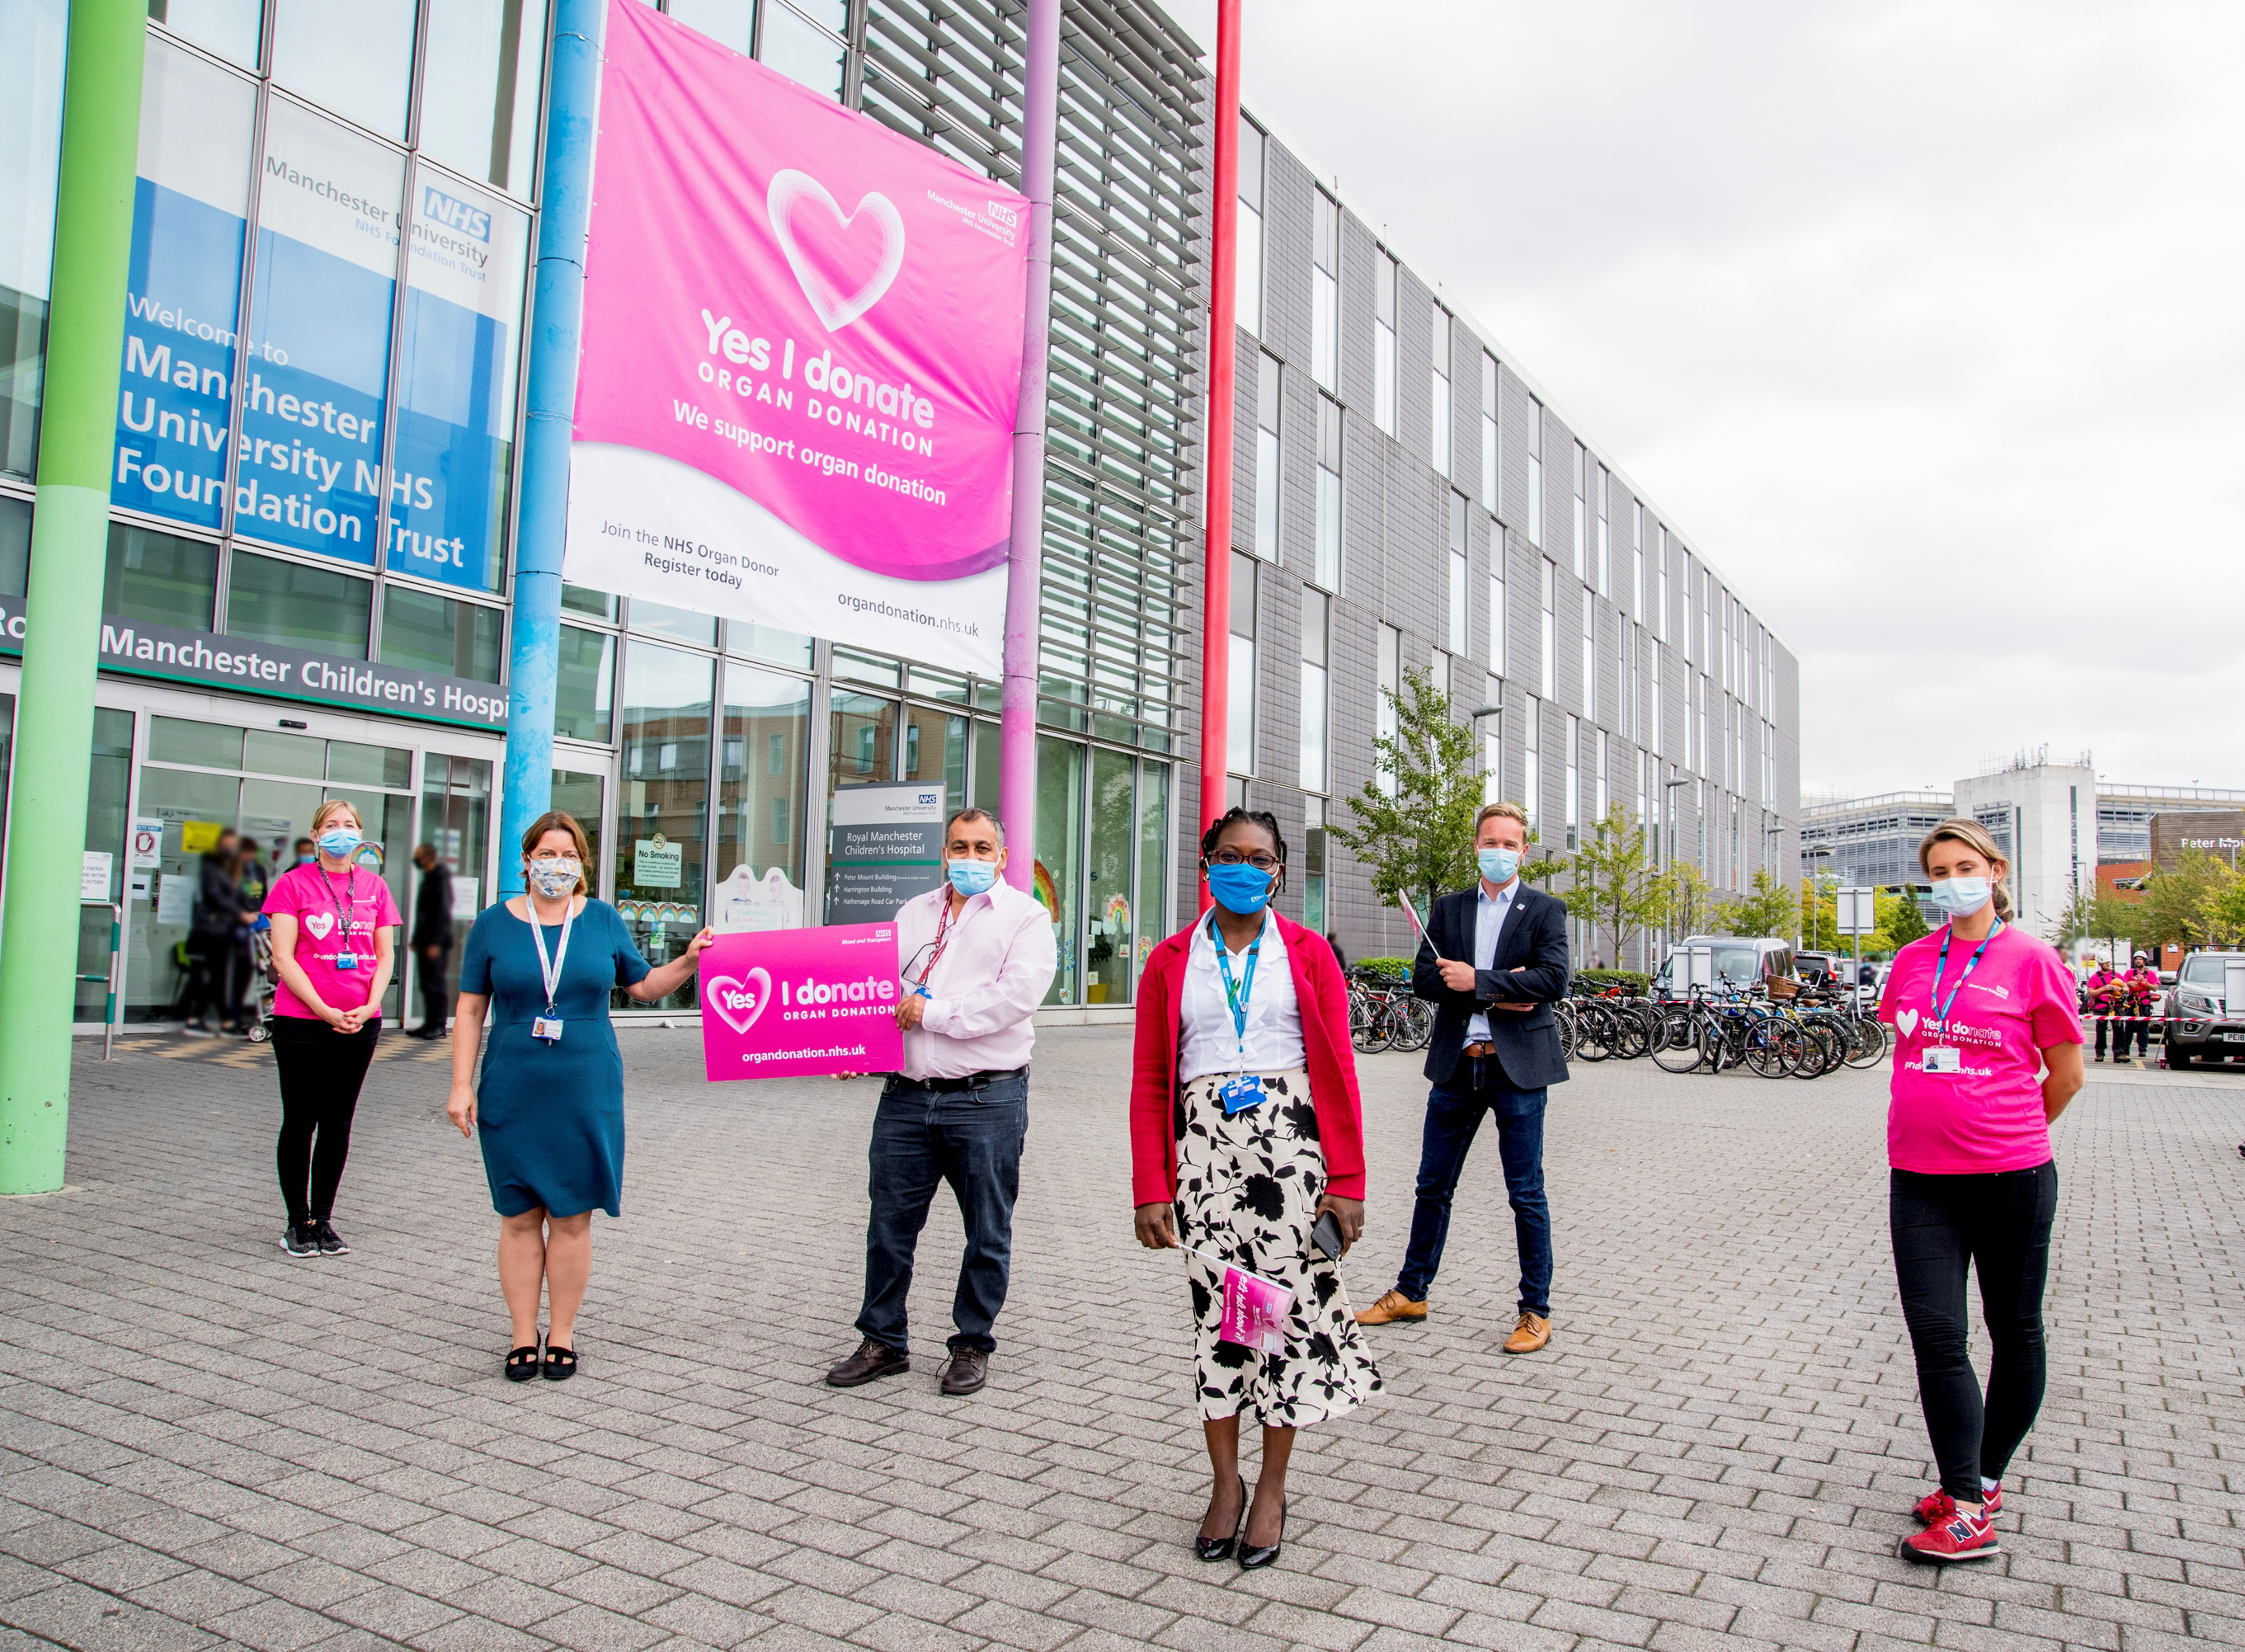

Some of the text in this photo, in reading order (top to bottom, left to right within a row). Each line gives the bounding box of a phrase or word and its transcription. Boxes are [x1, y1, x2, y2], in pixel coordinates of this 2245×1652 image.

[266, 156, 389, 223] Manchester
[426, 190, 490, 240] NHS
[927, 189, 1015, 241] Manchester University
[989, 201, 1016, 227] NHS
[962, 217, 1015, 247] NHS Foundation Trust
[355, 218, 487, 283] NHS Fondation Trust
[261, 341, 289, 365] to
[701, 308, 934, 429] Yes I donate
[698, 361, 933, 458] ORGAN DONATION
[672, 398, 946, 506] We support organ donation
[117, 446, 361, 543] Foundation
[354, 459, 433, 510] NHS
[601, 519, 779, 578] Join the NHS Organ Donor
[644, 552, 743, 590] Register today
[837, 591, 980, 638] organdonation.nhs.uk
[101, 624, 510, 723] Manchester Children's Hospi
[919, 794, 936, 803] NHS
[845, 844, 925, 856] Children's Hospital
[847, 831, 922, 844] Royal Manchester
[2181, 838, 2215, 848] Peter
[638, 850, 679, 862] No Smoking
[870, 886, 892, 894] Building
[722, 990, 755, 1010] Yes
[782, 976, 894, 1006] I donate
[784, 1005, 896, 1021] ORGAN DONATION
[1945, 1019, 1950, 1032] I
[1951, 1021, 2002, 1040] donate
[1952, 1035, 2002, 1047] DONATION
[742, 1044, 866, 1063] organdonation.nhs.uk
[1235, 1307, 1249, 1334] about
[1946, 1519, 1974, 1544] N
